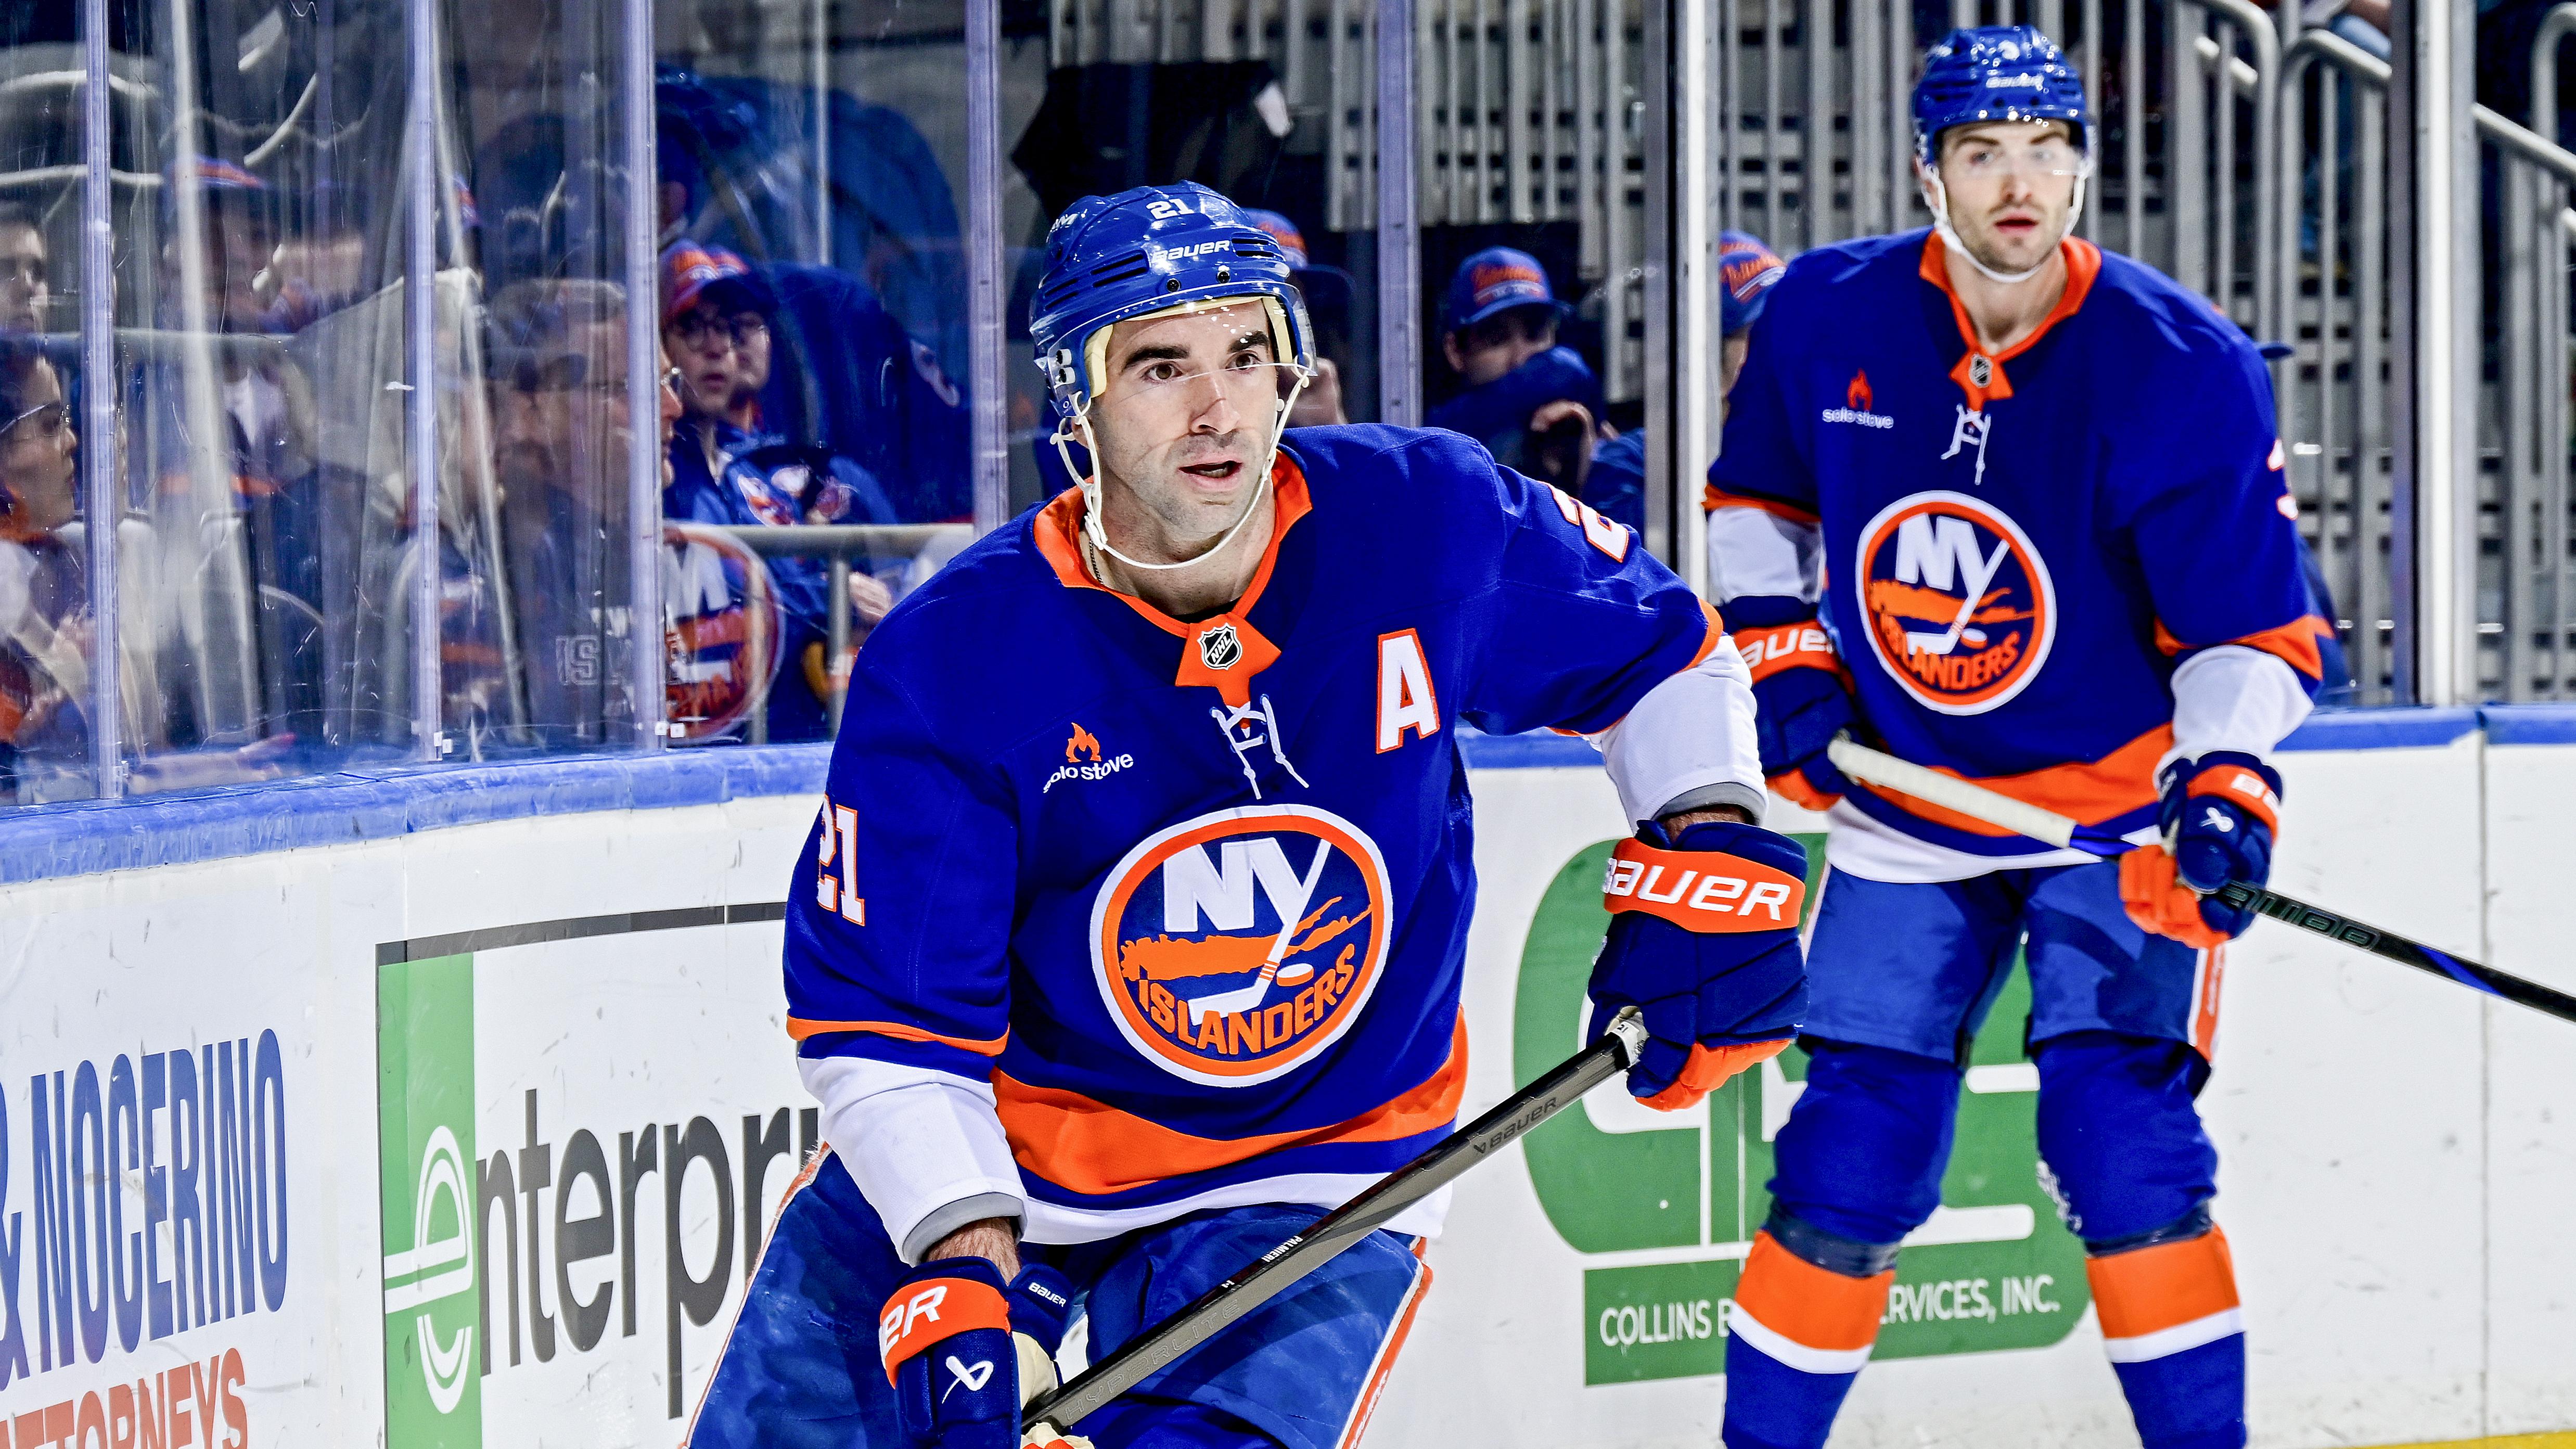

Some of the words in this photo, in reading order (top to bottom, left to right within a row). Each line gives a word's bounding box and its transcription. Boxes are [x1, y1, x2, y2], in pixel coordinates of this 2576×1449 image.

[1146, 199, 1194, 219] 21
[1152, 240, 1230, 263] BAUER
[1822, 406, 1855, 422] solo
[1895, 512, 2010, 617] NY
[1210, 635, 1231, 663] NHL
[1739, 629, 1833, 670] AUE
[1376, 628, 1440, 753] A
[1043, 766, 1079, 793] solo
[1081, 754, 1134, 780] stove
[1163, 837, 1332, 968] NY
[1139, 944, 1355, 1055] ISLANDERS
[1490, 1097, 1557, 1149] BAUER
[31, 1029, 287, 1374] NOCERINO
[1261, 1236, 1303, 1262] PALMIERI
[1029, 1282, 1067, 1307] BAUER
[1879, 1278, 1996, 1324] RVICES,
[2002, 1274, 2061, 1315] INC.
[1600, 1300, 1712, 1346] COLLINS
